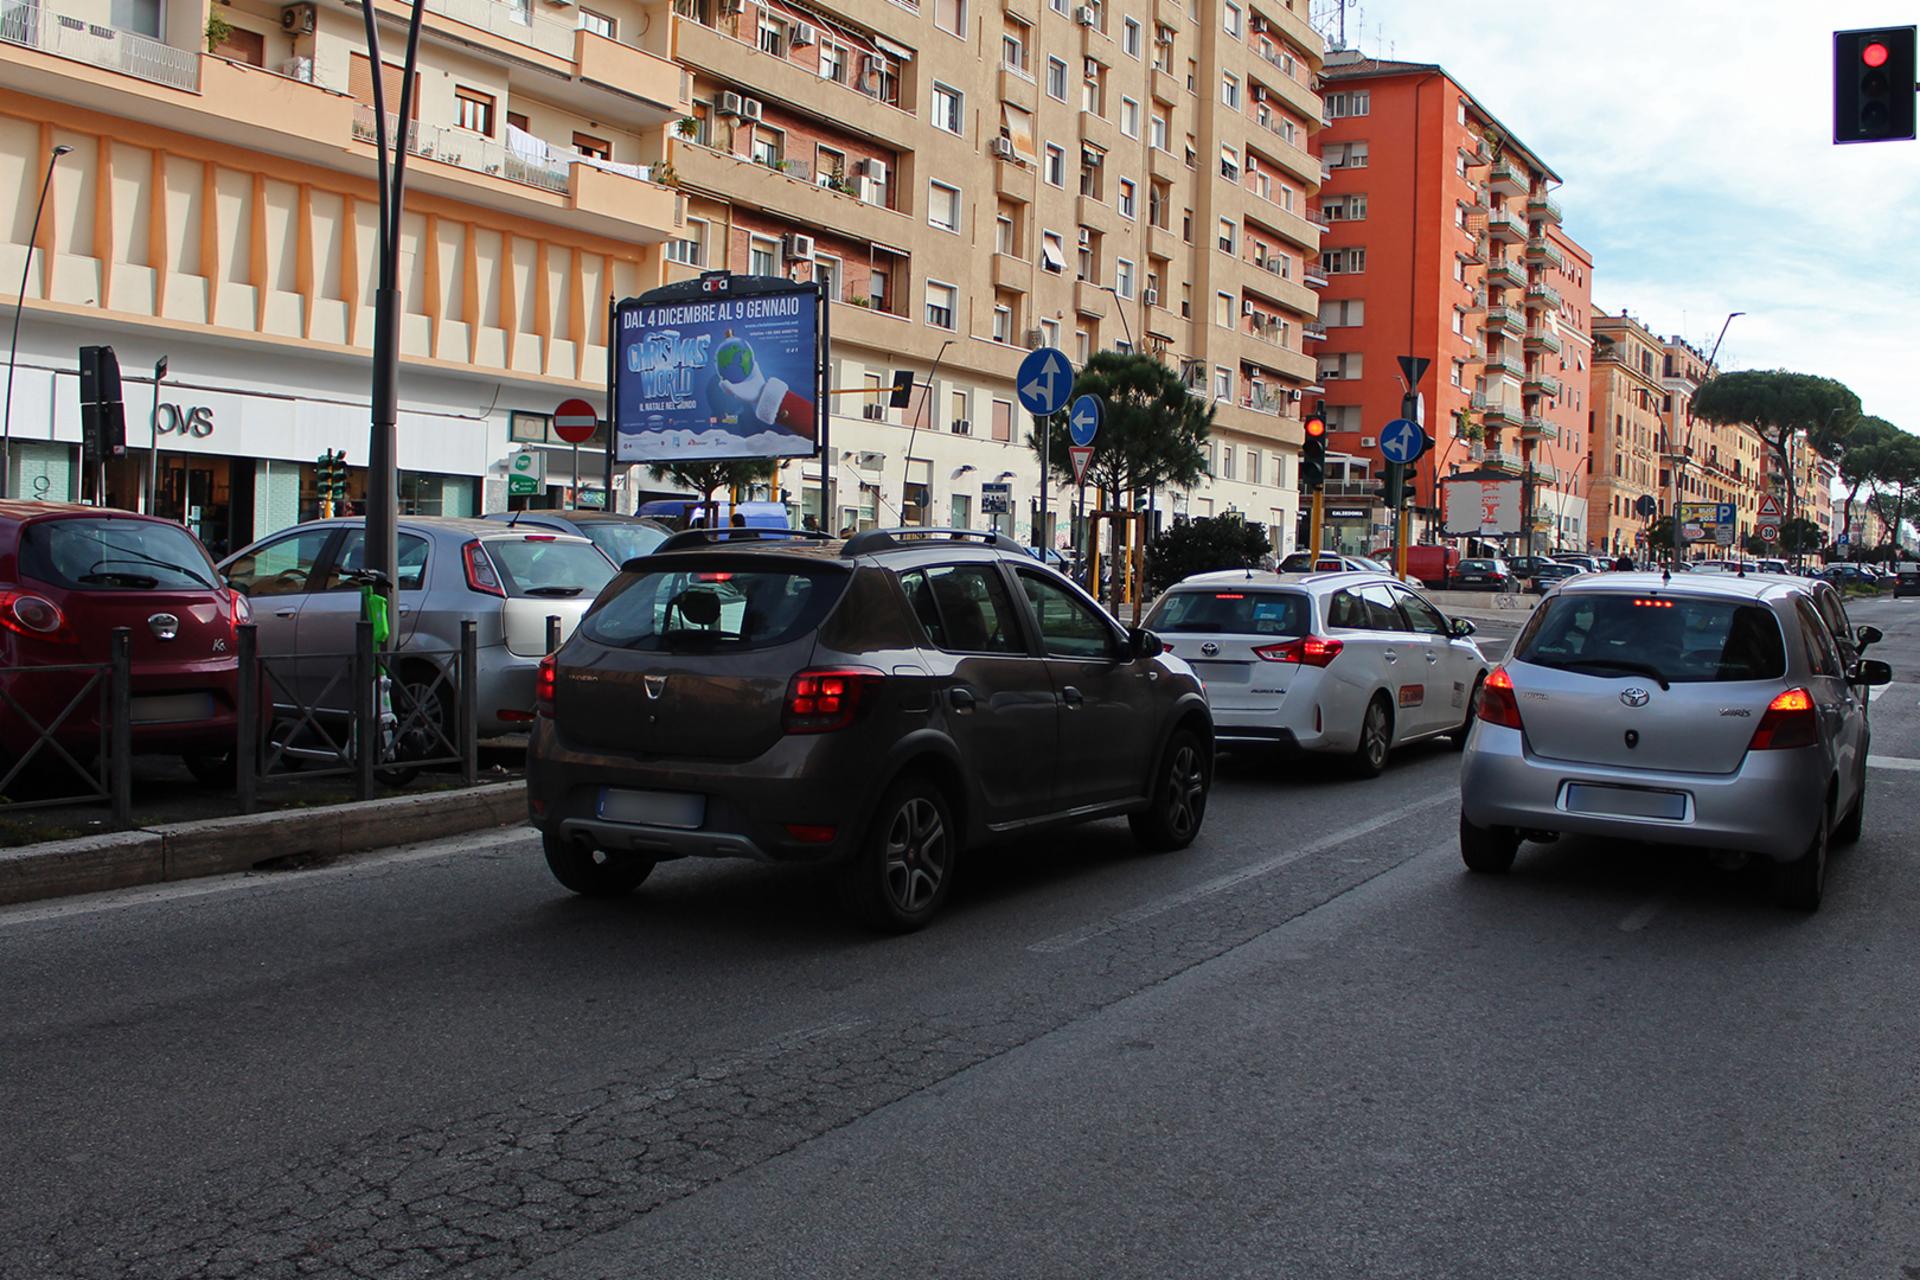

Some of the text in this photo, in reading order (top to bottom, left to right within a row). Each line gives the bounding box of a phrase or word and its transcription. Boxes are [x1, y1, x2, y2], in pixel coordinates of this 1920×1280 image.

[624, 297, 799, 329] DAL 4 DICEMBRE AL 9 GENNAIO
[627, 329, 712, 372] CHRISTMAS
[640, 366, 694, 404] WORLD
[150, 402, 214, 438] OVS
[645, 401, 665, 411] NATALE
[1719, 505, 1731, 522] P
[1764, 528, 1774, 538] 30
